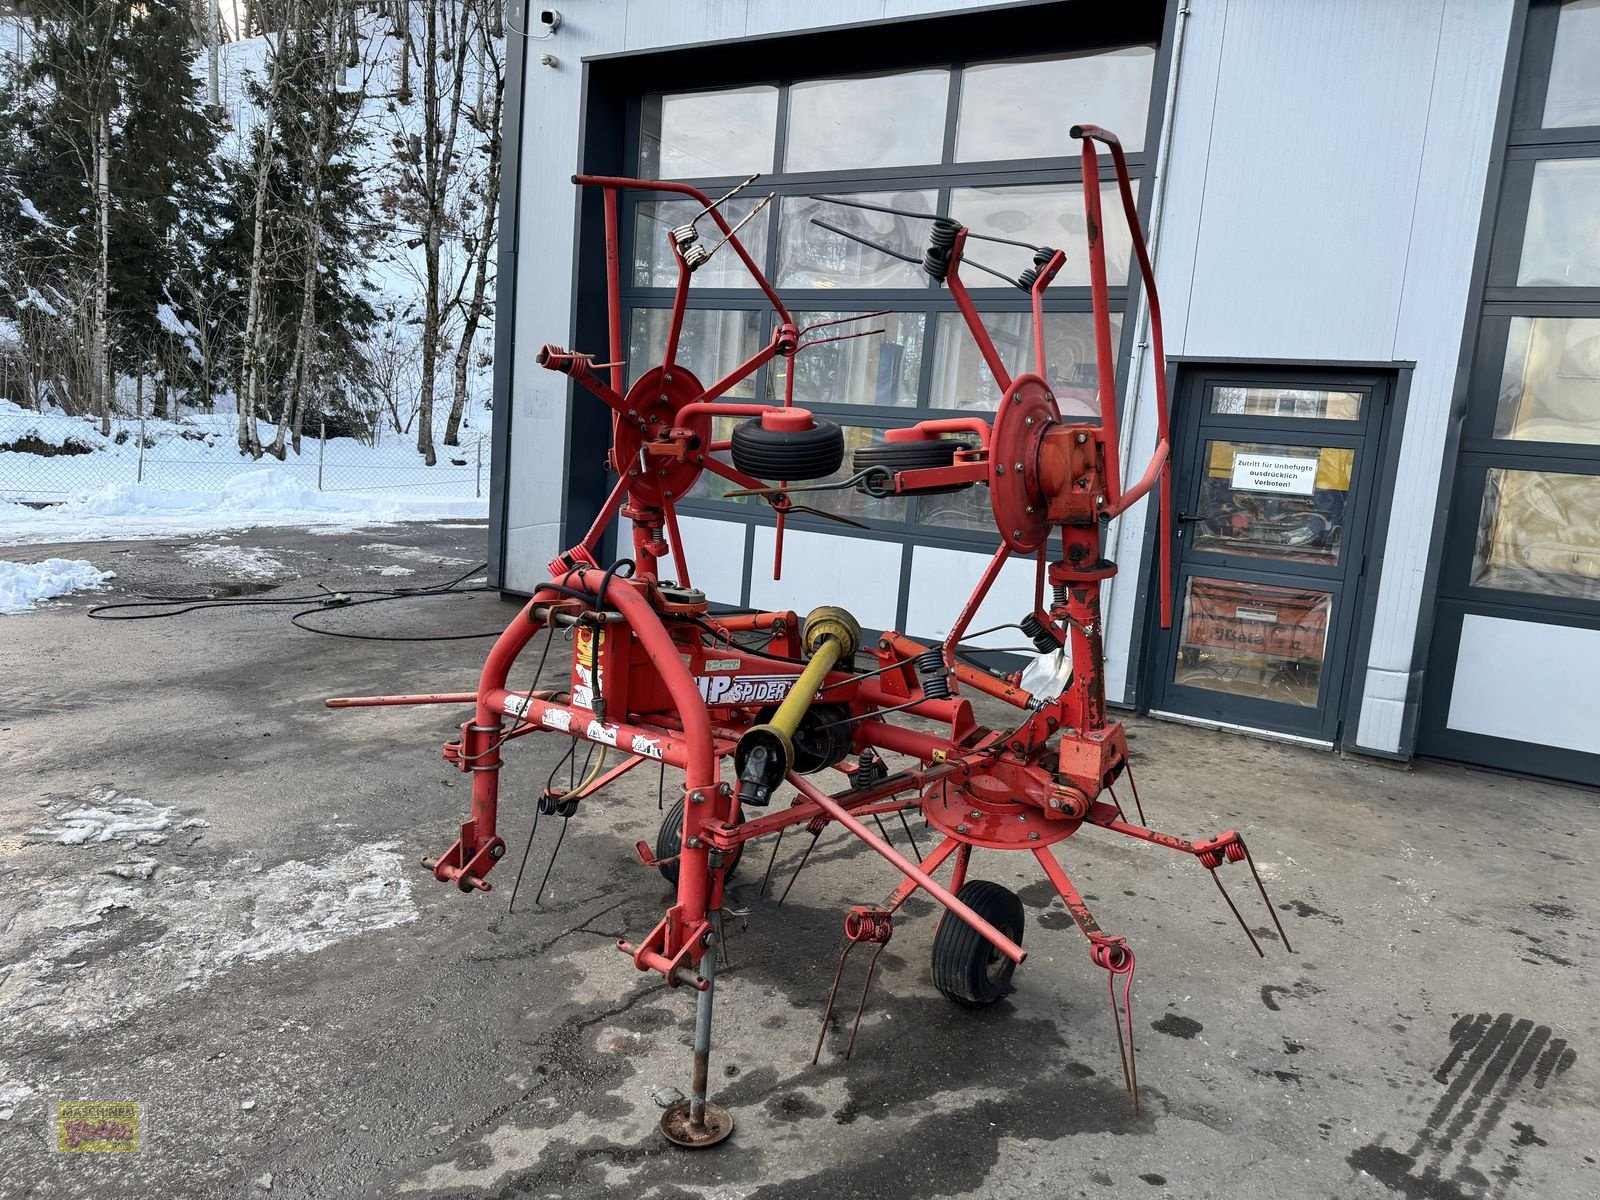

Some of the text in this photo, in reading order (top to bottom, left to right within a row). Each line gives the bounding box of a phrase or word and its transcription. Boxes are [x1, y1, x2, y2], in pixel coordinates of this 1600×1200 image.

[1238, 460, 1313, 473] Zutritt für Unbefugte
[1249, 470, 1298, 480] ausdrücklich
[1254, 479, 1291, 488] Verboten!
[693, 675, 787, 704] IP SPIDER
